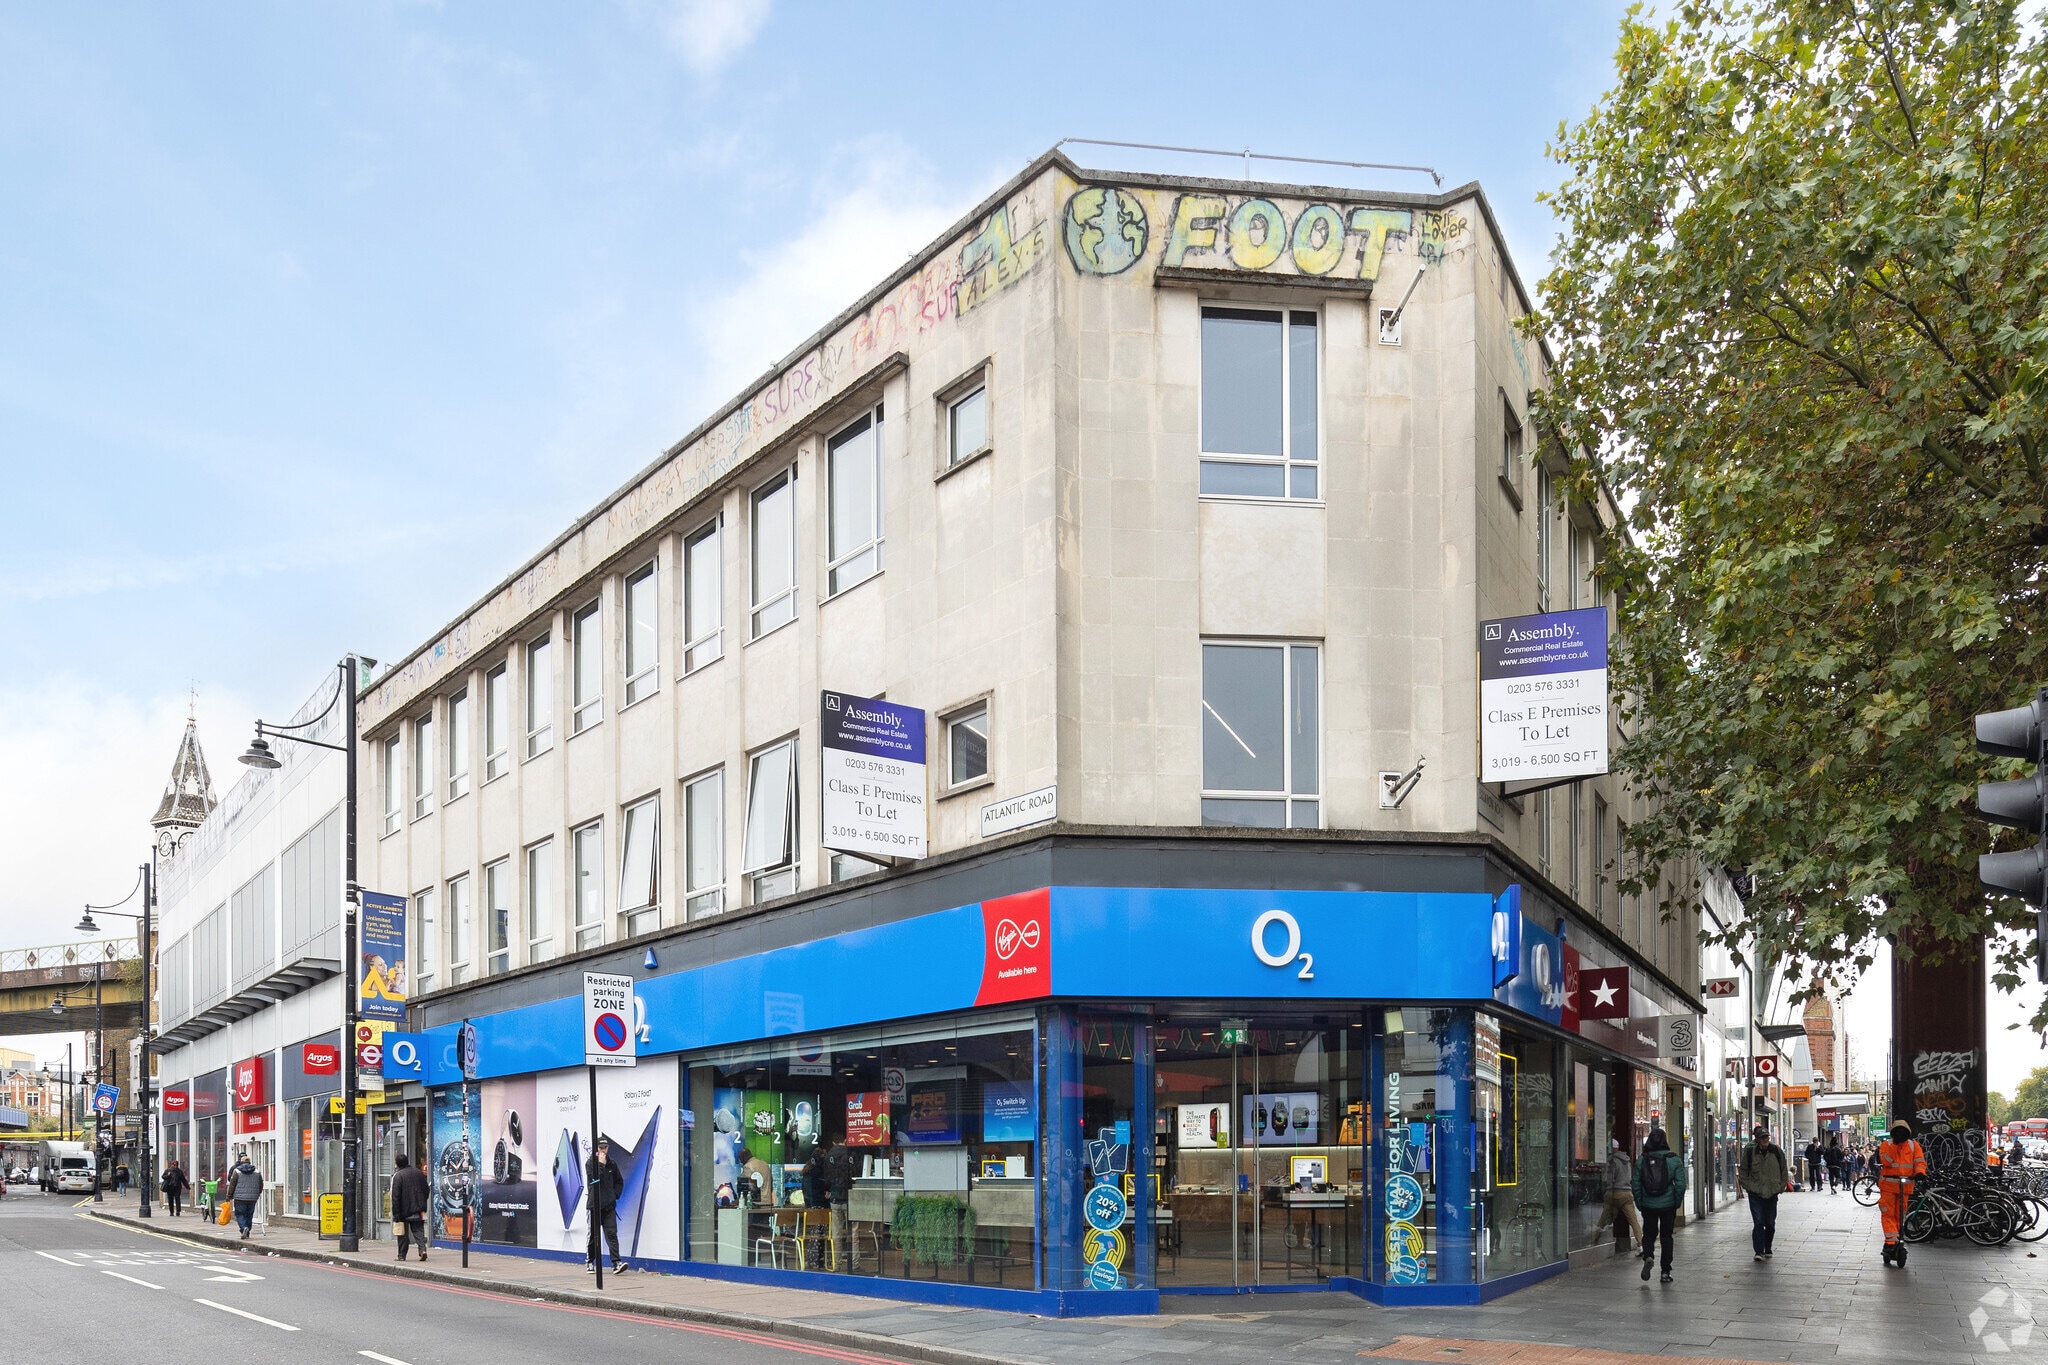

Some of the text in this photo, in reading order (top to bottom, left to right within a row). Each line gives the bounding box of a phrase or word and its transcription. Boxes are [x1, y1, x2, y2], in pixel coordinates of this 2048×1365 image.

[1161, 192, 1413, 282] FOOT
[1507, 623, 1580, 643] Assembly.
[1504, 644, 1544, 654] Commercial
[1562, 640, 1584, 648] Estate
[1499, 650, 1589, 666] www.assemblycre.co.uk
[1508, 679, 1580, 694] 0203 576 3331
[845, 704, 905, 729] Assembly.
[1488, 703, 1601, 724] Class E Premises
[842, 721, 908, 739] Commercial Real Estate
[1519, 724, 1570, 741] To Let
[838, 731, 912, 750] www.assemblycre.co.uk
[1563, 752, 1580, 763] SQ
[1584, 750, 1598, 760] FT
[845, 758, 905, 776] 0203 576 3331
[829, 778, 922, 805] Class E Premises
[855, 801, 897, 820] To Let
[984, 793, 1054, 822] ATLANTIC ROAD
[892, 834, 906, 845] SQ
[909, 836, 919, 846] FT
[366, 915, 391, 923] Unlimited
[998, 966, 1037, 978] Available here
[587, 976, 630, 987] Restricted
[594, 988, 624, 998] parking
[594, 999, 625, 1010] ZONE
[306, 1052, 333, 1064] Argos
[239, 1067, 252, 1092] Argos
[848, 1101, 862, 1109] Grab
[1389, 1072, 1400, 1133] LIVING
[1390, 1138, 1400, 1172] FOR
[1096, 1195, 1118, 1212] 20%
[1096, 1208, 1111, 1219] off
[1094, 1271, 1114, 1282] savings
